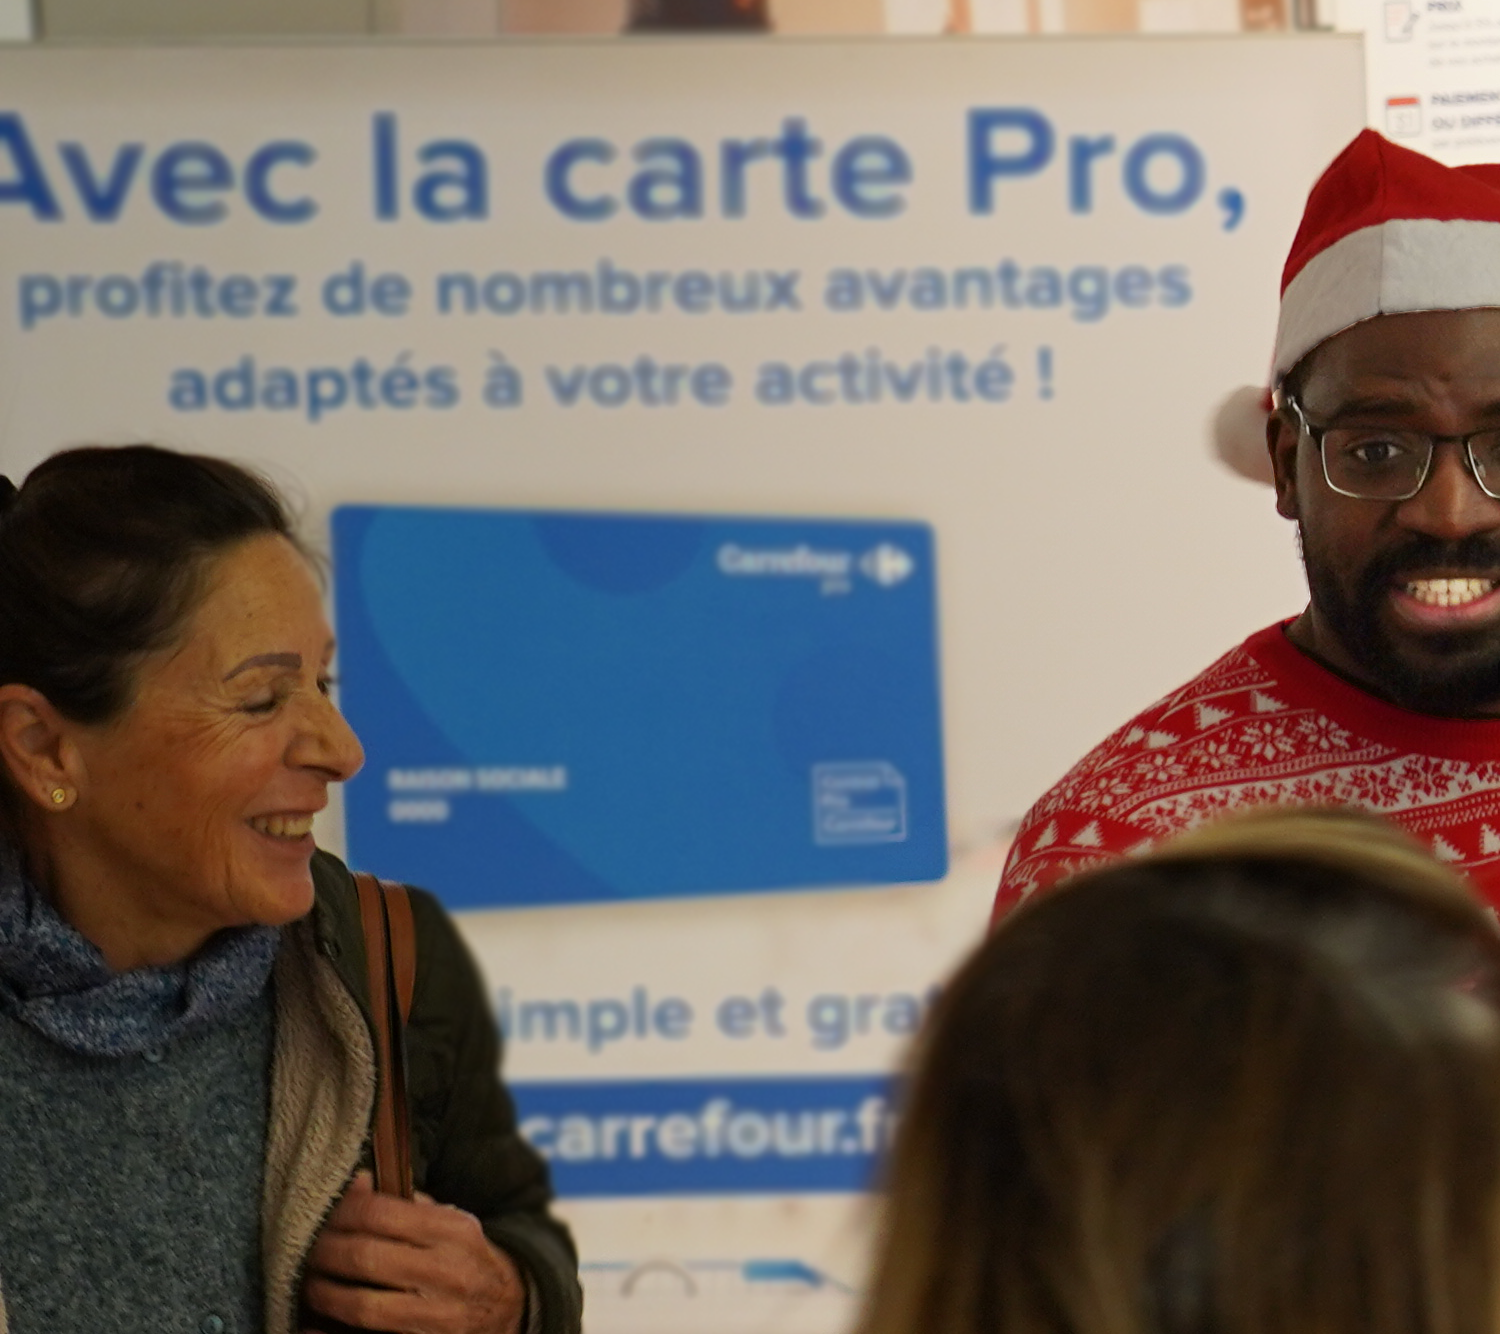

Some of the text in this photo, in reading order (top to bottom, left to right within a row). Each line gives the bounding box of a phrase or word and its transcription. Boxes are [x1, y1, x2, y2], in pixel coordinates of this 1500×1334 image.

[374, 110, 490, 223] la
[543, 117, 912, 220] carte
[965, 106, 1245, 232] Pro,
[20, 258, 1191, 330] profitez de nombreux avantages
[168, 347, 1057, 422] adaptés à votre activité !
[718, 544, 852, 576] Carrefour
[503, 989, 694, 1051] imple
[717, 989, 784, 1041] et
